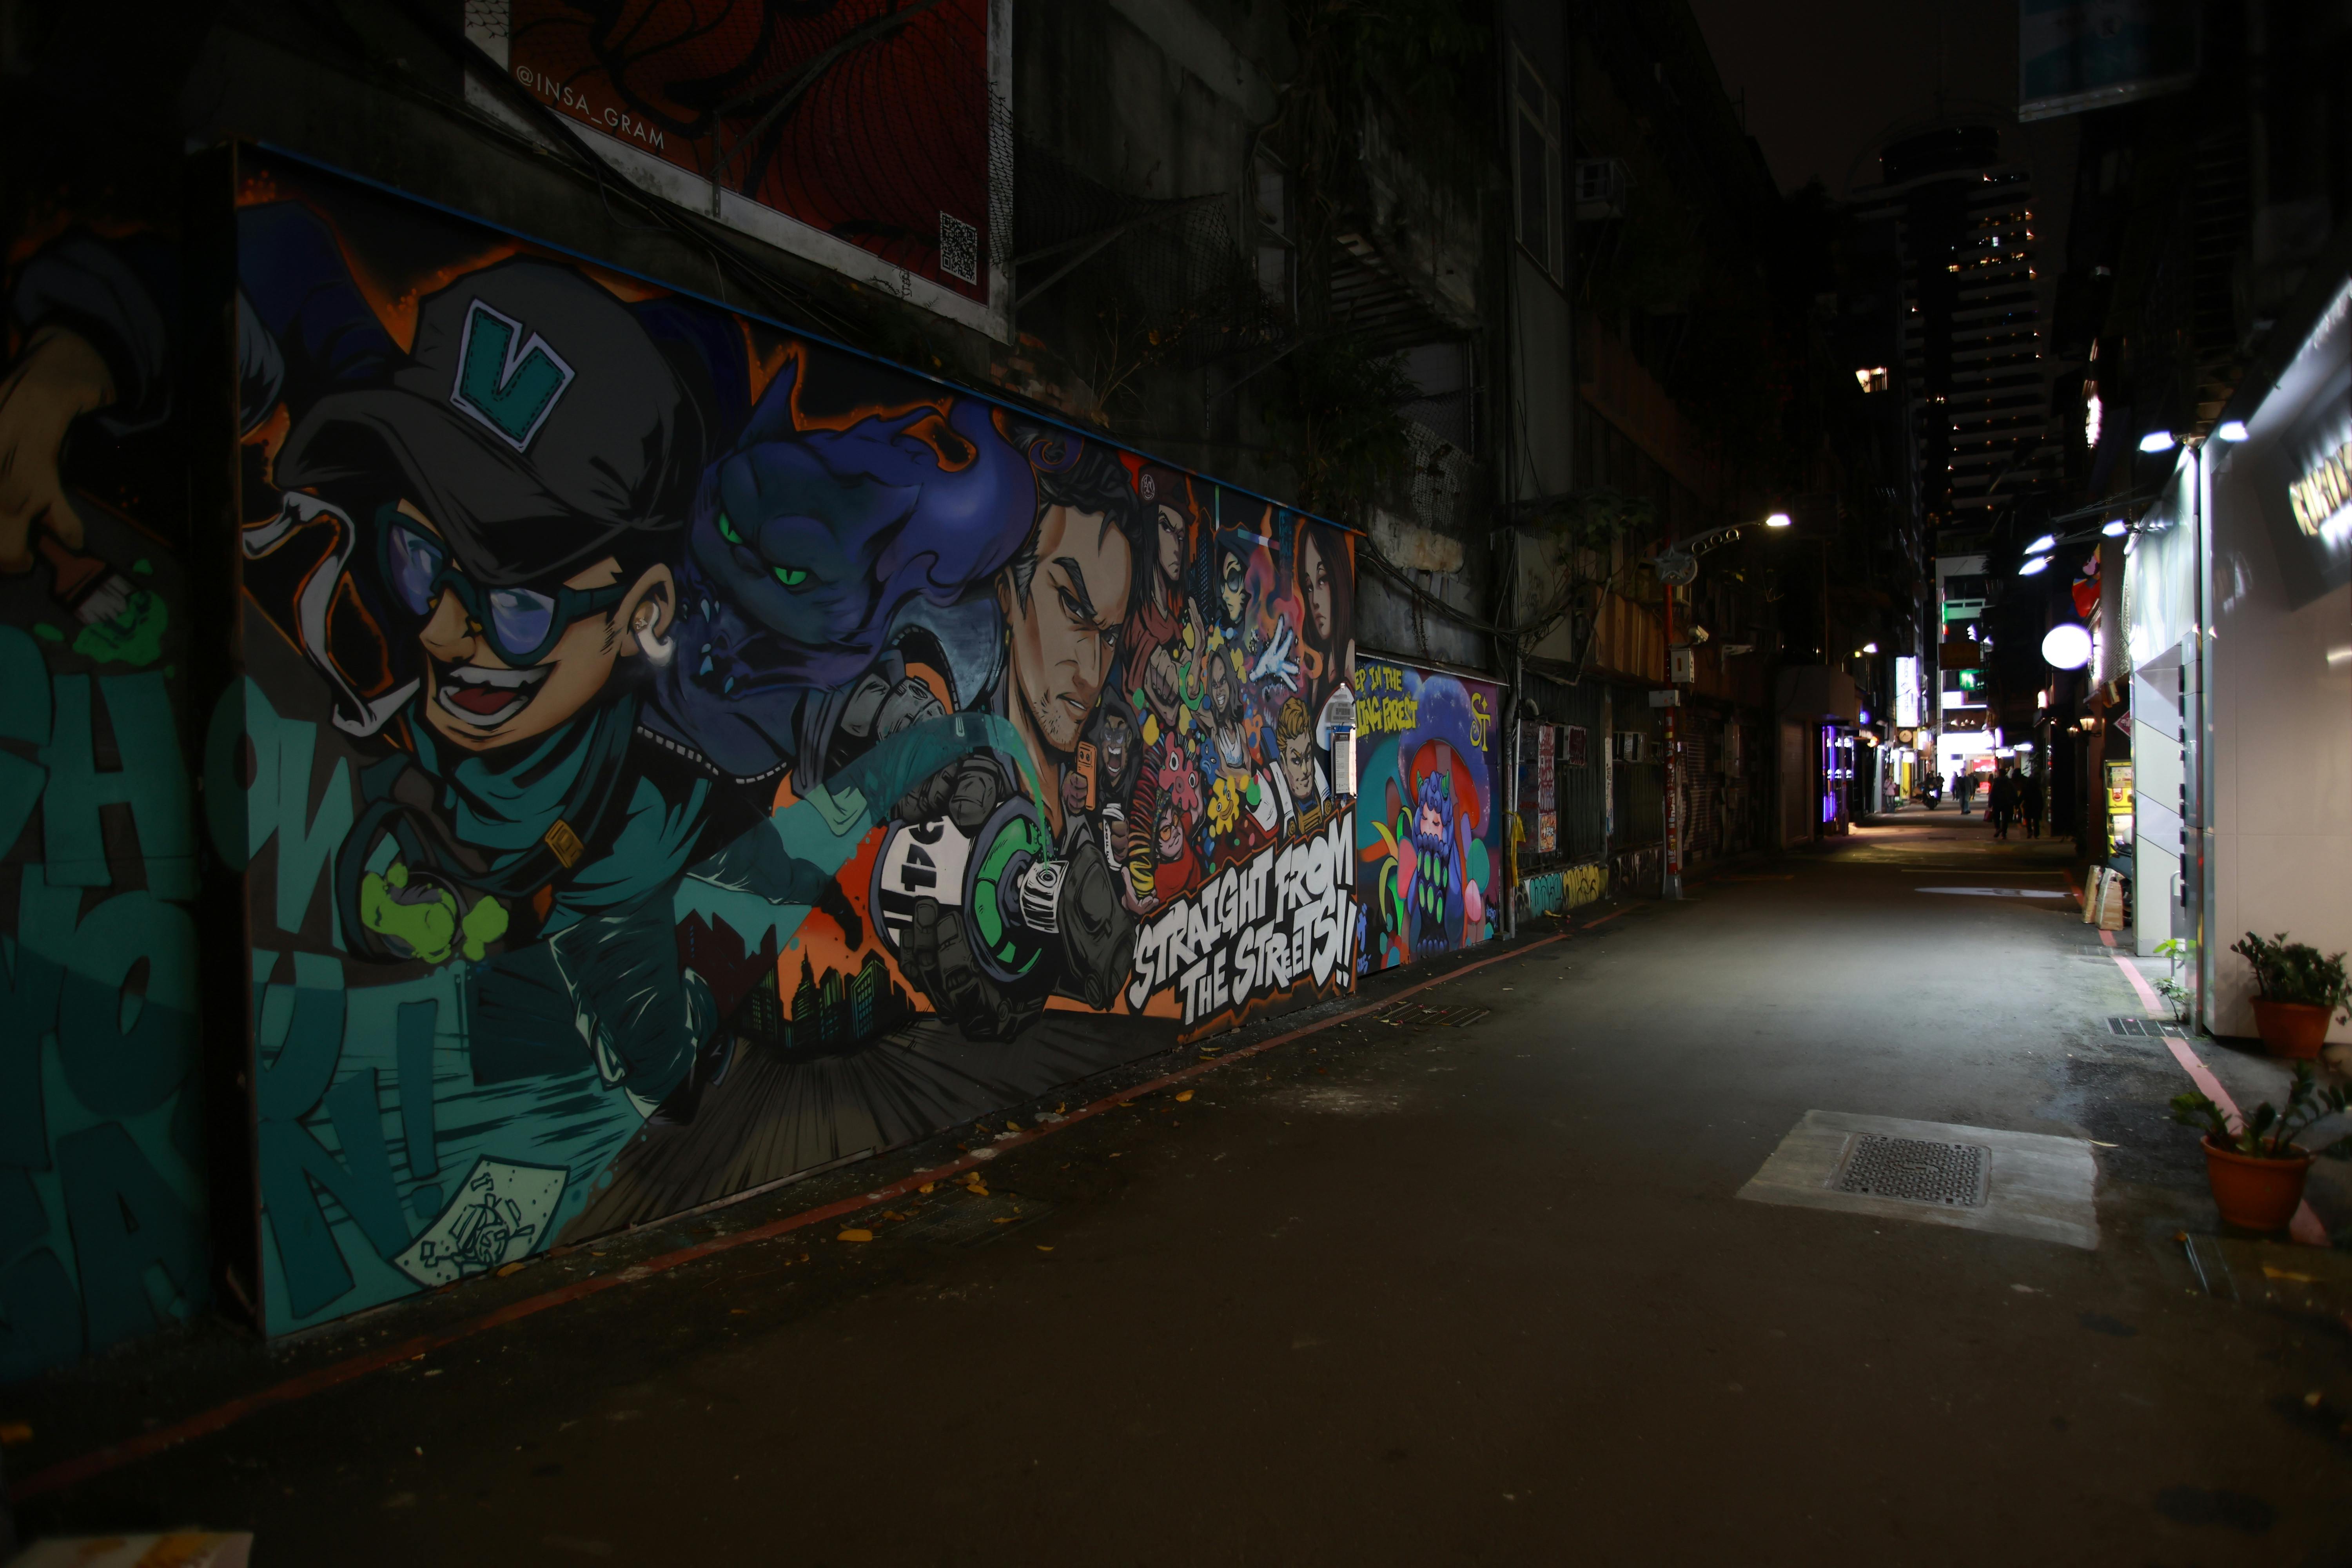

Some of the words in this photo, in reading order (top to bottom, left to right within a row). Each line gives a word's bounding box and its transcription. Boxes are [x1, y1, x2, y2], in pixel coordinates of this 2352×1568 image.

[517, 65, 664, 149] @INSA_GRAM
[1355, 668, 1367, 692] EP
[1369, 665, 1382, 691] IN
[1383, 666, 1402, 691] THE
[1382, 696, 1418, 733] FOREST
[1129, 846, 1274, 1009] STRAIGHT
[1275, 812, 1353, 923] FROM
[1180, 947, 1229, 1025] THE
[1232, 886, 1357, 1005] STREETS!!
